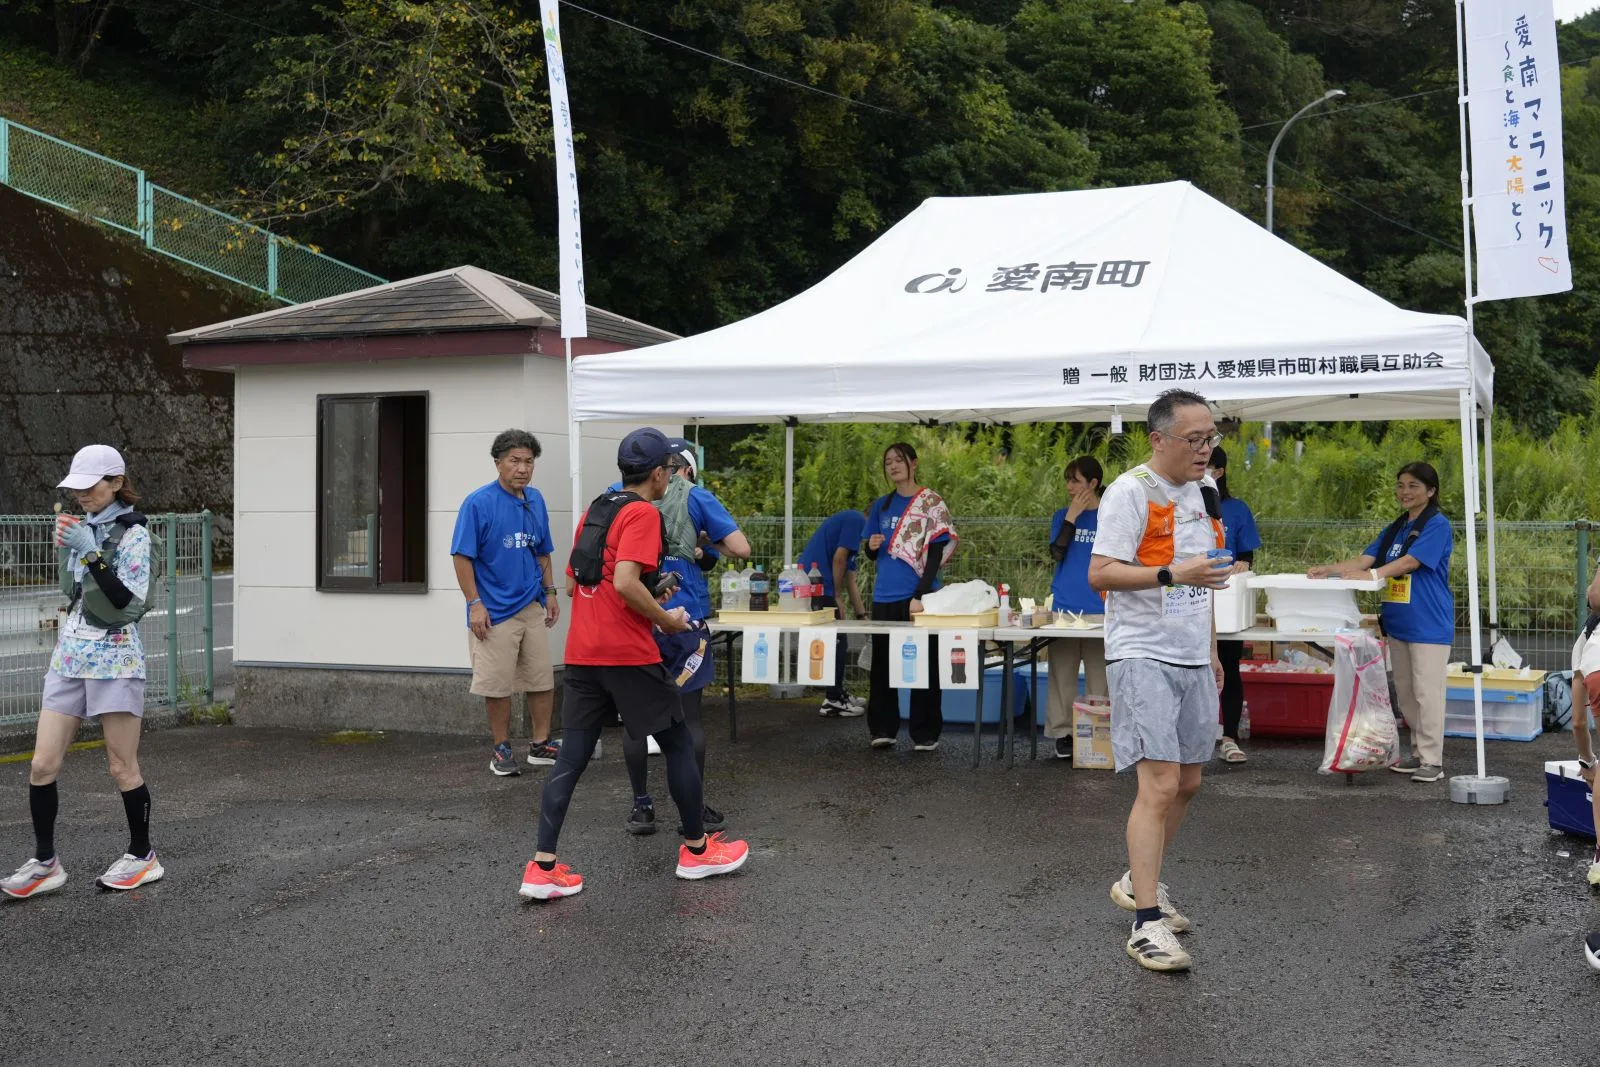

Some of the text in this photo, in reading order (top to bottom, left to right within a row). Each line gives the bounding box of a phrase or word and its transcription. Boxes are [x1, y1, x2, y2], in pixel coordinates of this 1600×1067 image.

[1514, 14, 1554, 249] 愛南マラニック
[985, 260, 1151, 293] 愛南町
